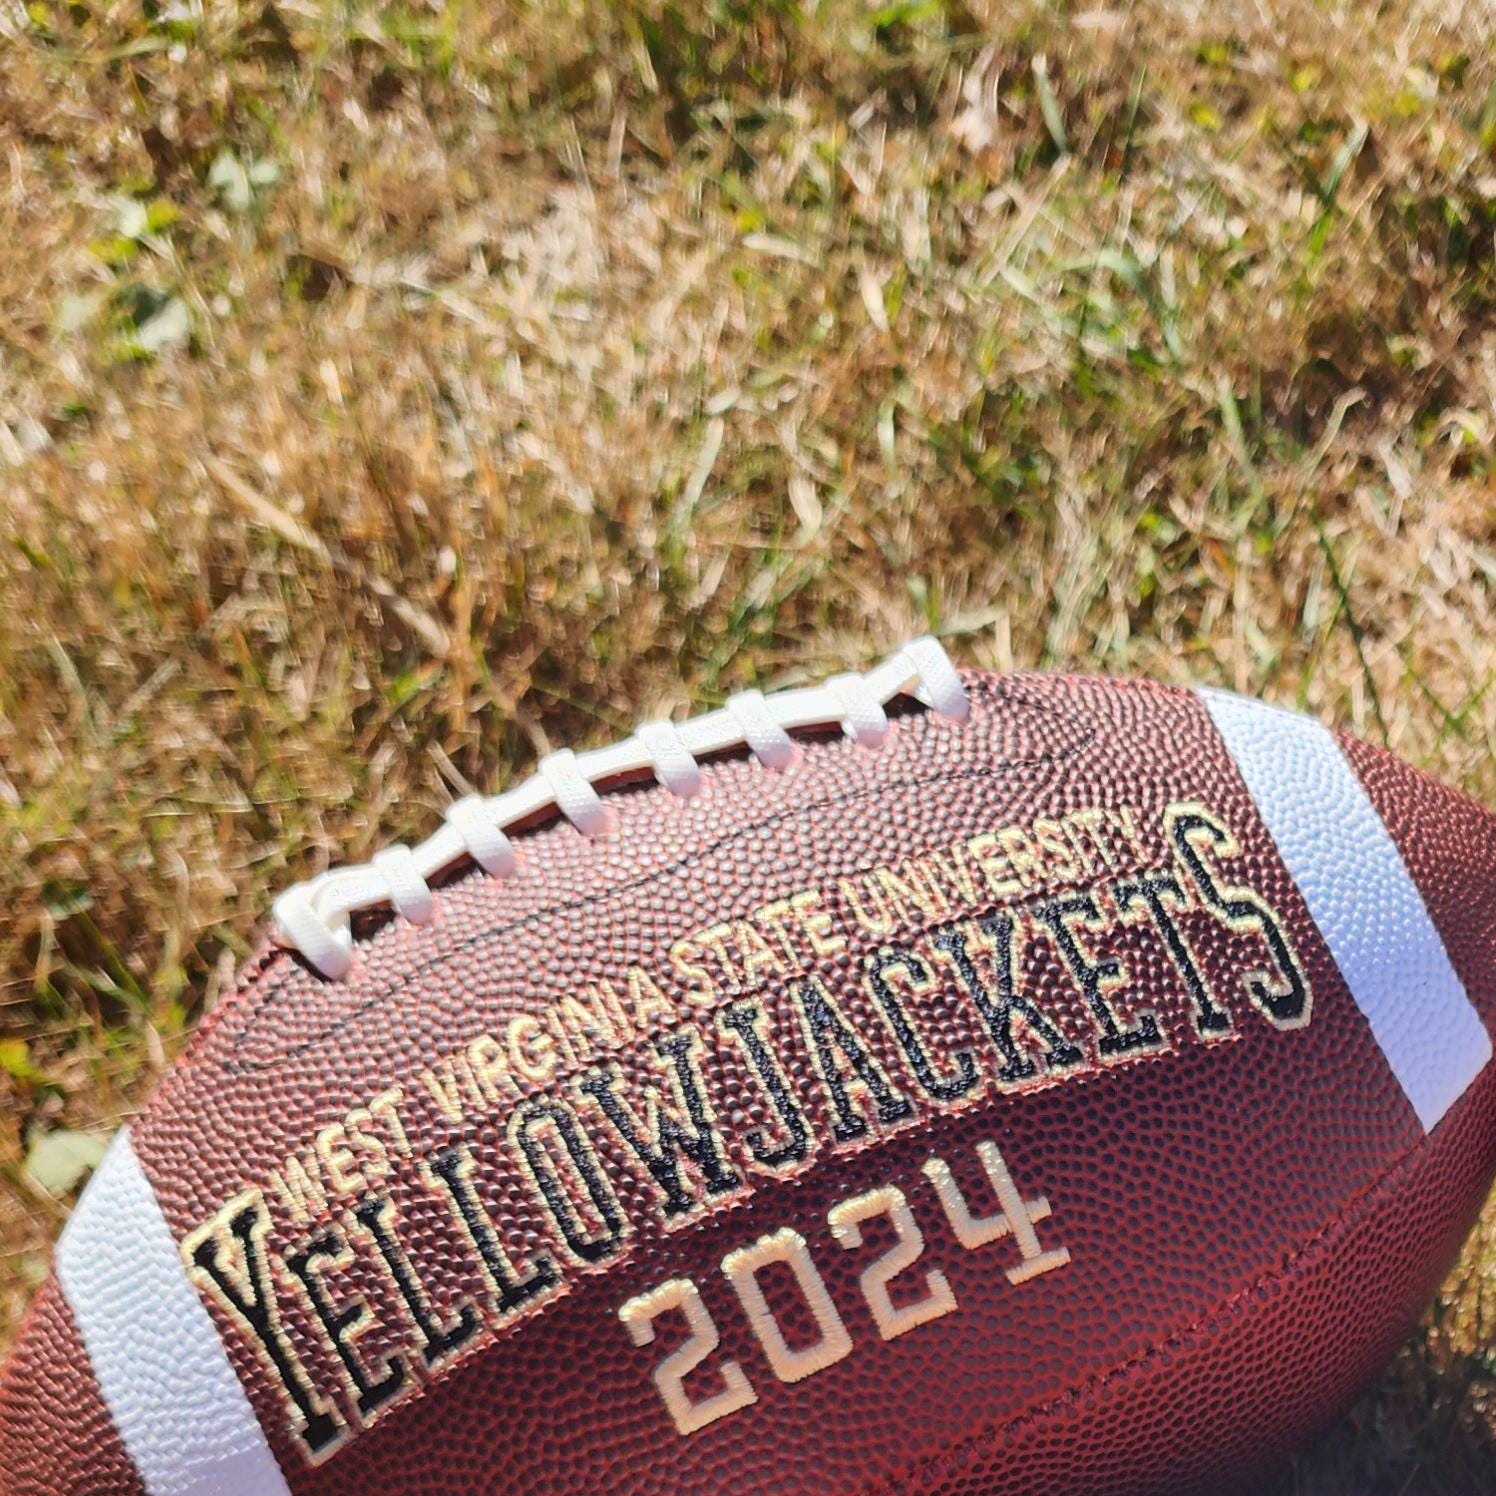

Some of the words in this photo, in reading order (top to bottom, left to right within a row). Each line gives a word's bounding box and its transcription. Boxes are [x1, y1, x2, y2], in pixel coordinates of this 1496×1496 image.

[180, 802, 1313, 1466] YELLOWJACKETS
[270, 1086, 413, 1223] WEST
[421, 967, 674, 1124] VIRGINIA
[670, 889, 849, 1005] STATE
[841, 806, 1154, 934] UNIVERSITY
[617, 1140, 1071, 1434] 2024
